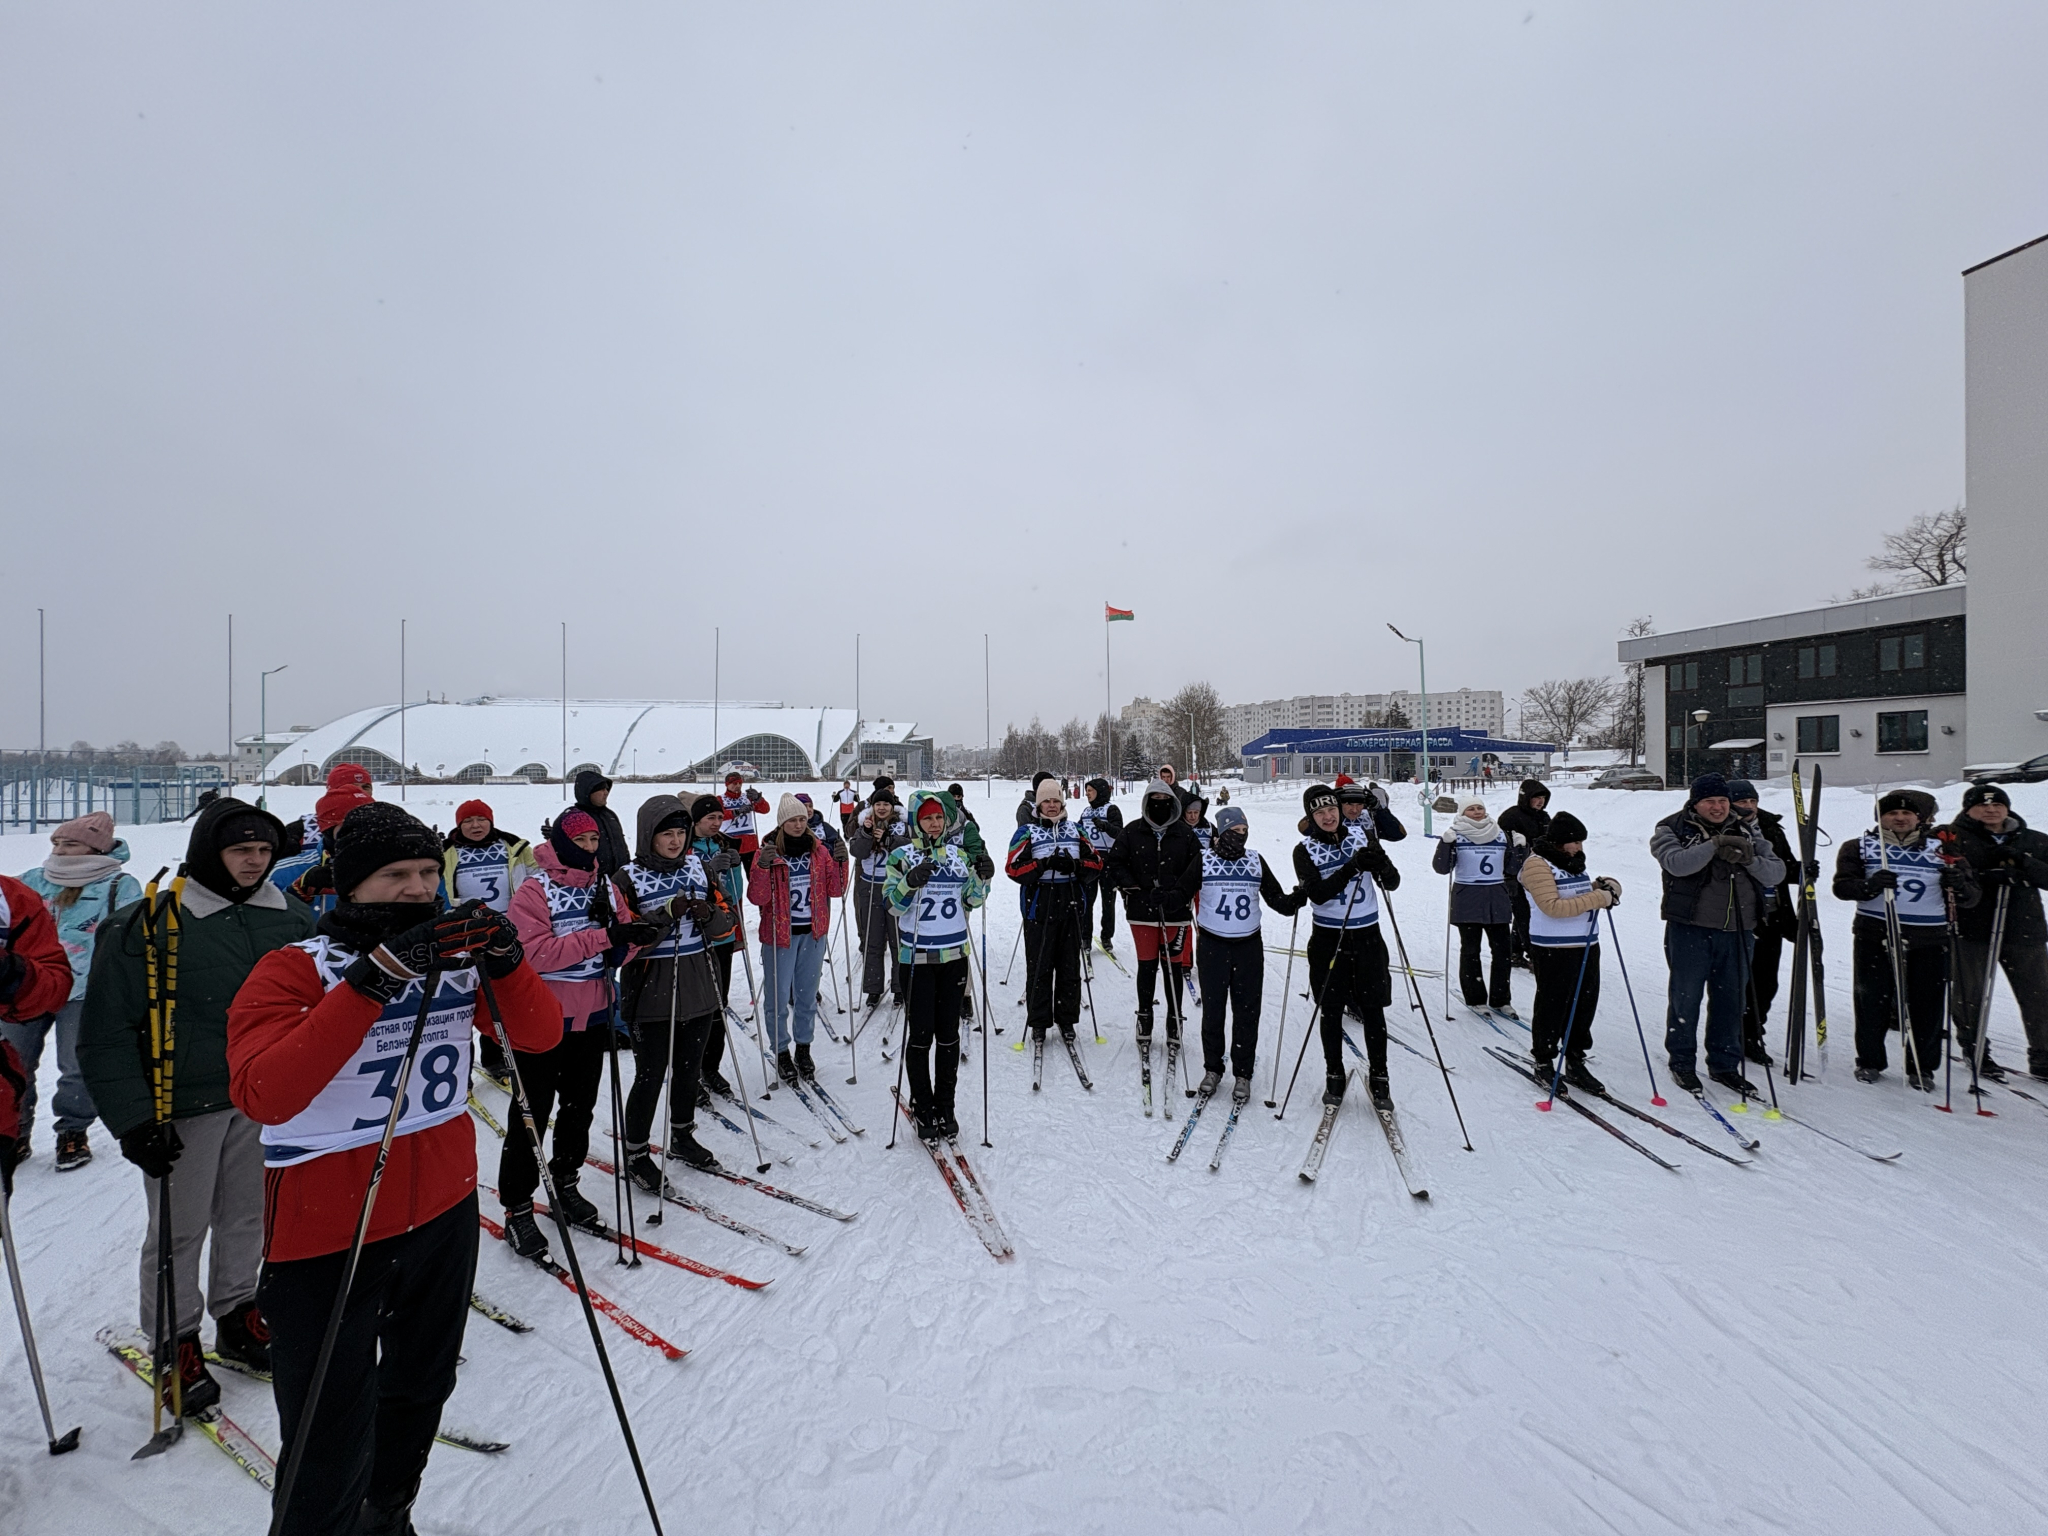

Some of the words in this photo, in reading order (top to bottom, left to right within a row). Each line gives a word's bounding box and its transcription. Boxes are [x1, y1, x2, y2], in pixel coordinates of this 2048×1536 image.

[1793, 772, 1806, 825] FISCHER
[731, 814, 749, 828] 42
[1480, 855, 1494, 876] 6
[480, 876, 500, 903] 3
[918, 898, 958, 921] 28
[1215, 894, 1251, 921] 48
[402, 1012, 455, 1035] оргизация
[377, 1029, 449, 1054] Белэнеотопгаз
[352, 1044, 460, 1130] 38
[532, 1146, 550, 1184] SPORT
[508, 1223, 521, 1250] MADSHUS
[679, 1256, 725, 1279] MADSHUS
